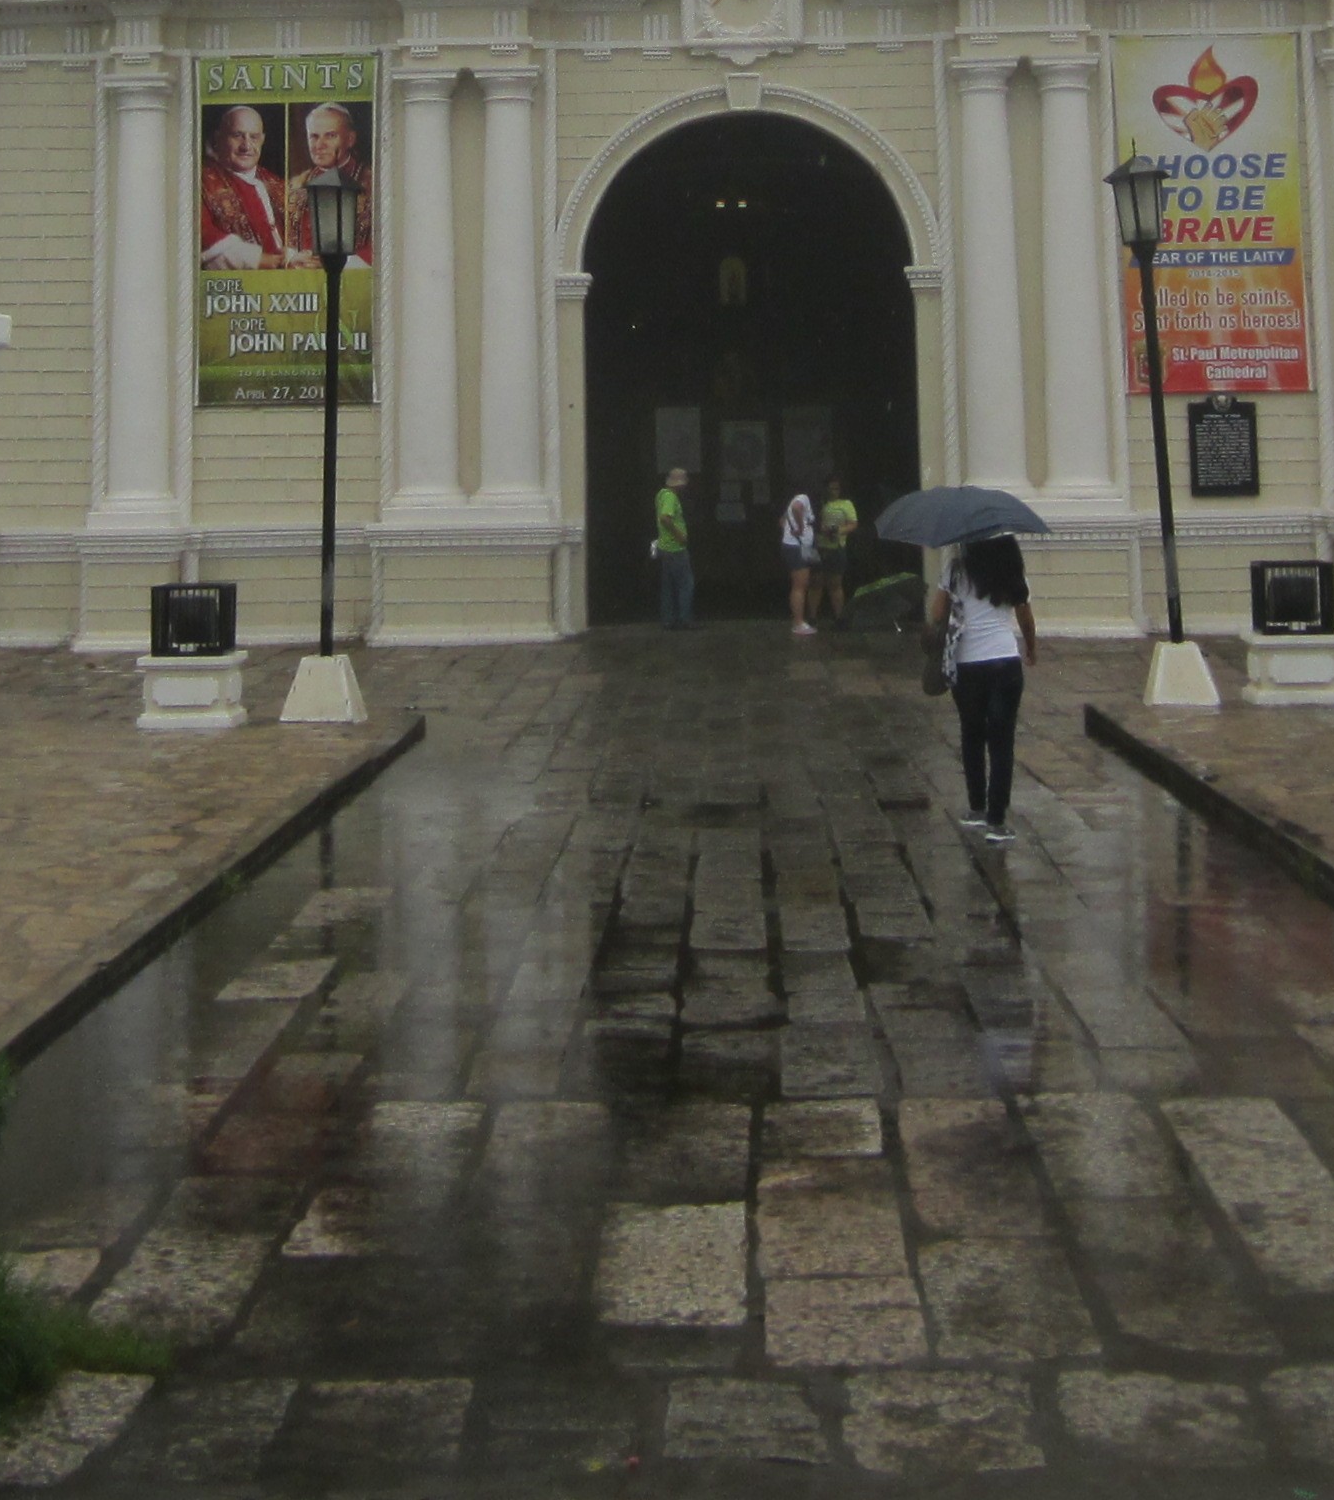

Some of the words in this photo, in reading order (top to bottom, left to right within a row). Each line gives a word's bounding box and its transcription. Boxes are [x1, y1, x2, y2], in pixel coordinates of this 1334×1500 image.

[207, 60, 365, 94] SAINTS
[1137, 153, 1288, 180] HOOSE
[1216, 185, 1266, 211] BE
[1152, 253, 1180, 265] EAR
[1185, 252, 1204, 264] OF
[1210, 251, 1239, 264] THE
[1243, 250, 1286, 263] LAITY
[1187, 269, 1241, 279] 2014-2015
[205, 279, 243, 293] POPE
[204, 294, 262, 318] JOHN
[269, 293, 319, 313] XXIII
[1195, 289, 1210, 307] to
[1216, 287, 1235, 306] be
[1240, 288, 1293, 306] saints.
[229, 317, 266, 331] POPE
[1133, 312, 1169, 331] Snt
[1175, 310, 1212, 329] forth
[1218, 314, 1237, 329] as
[1242, 309, 1300, 329] heroes!
[228, 332, 285, 358] JOHN
[353, 332, 367, 351] II
[1172, 346, 1188, 362] St.
[1190, 346, 1218, 361] Paul
[1220, 345, 1299, 361] Metropolitan
[1205, 364, 1268, 380] Cathedral
[272, 386, 294, 400] 27,
[298, 386, 326, 399] 201
